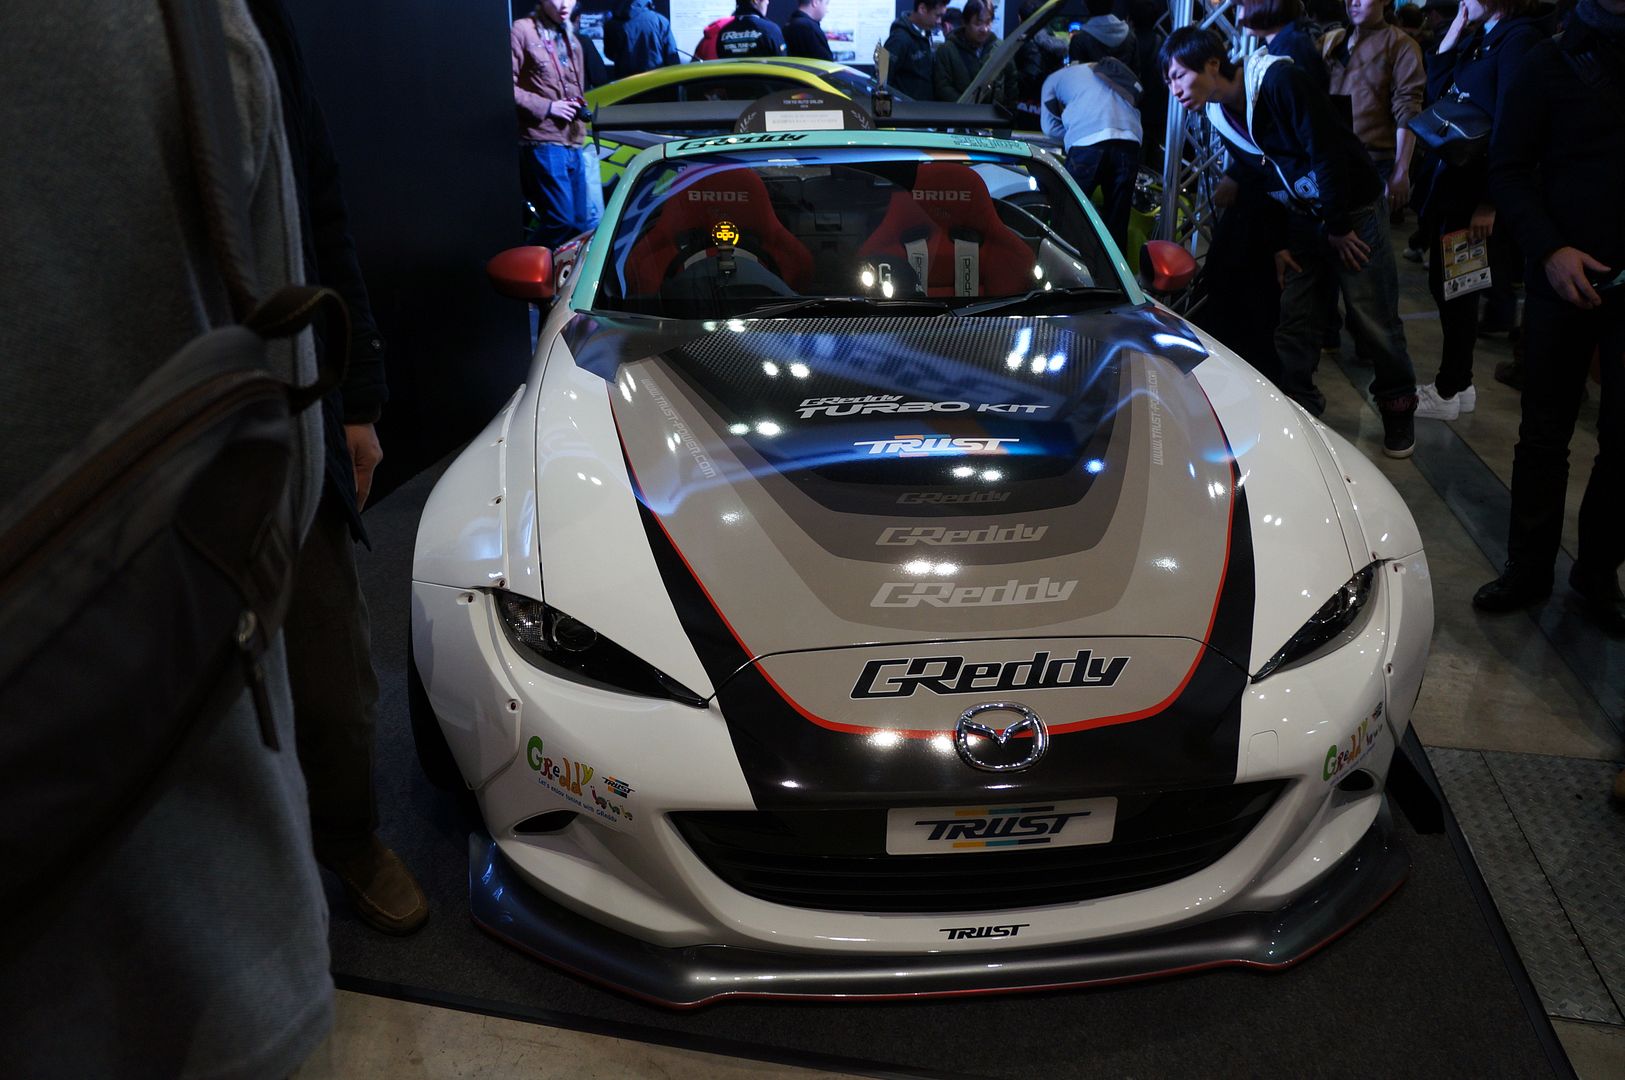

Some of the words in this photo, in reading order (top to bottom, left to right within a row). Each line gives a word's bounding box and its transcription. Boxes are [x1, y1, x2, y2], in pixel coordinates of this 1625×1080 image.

[687, 190, 749, 202] BRIDE
[911, 189, 972, 201] BRIDE
[799, 394, 904, 407] GReddy
[795, 401, 970, 419] TURBO
[976, 403, 1051, 413] KIT
[853, 437, 1020, 455] TRUST
[896, 490, 1012, 505] GReddy
[874, 523, 1049, 547] GReddy
[869, 576, 1079, 608] GReddy
[850, 649, 1131, 701] GReddy
[601, 776, 636, 794] TRUST
[915, 811, 1092, 841] TRUST
[939, 923, 1030, 940] TRUST
